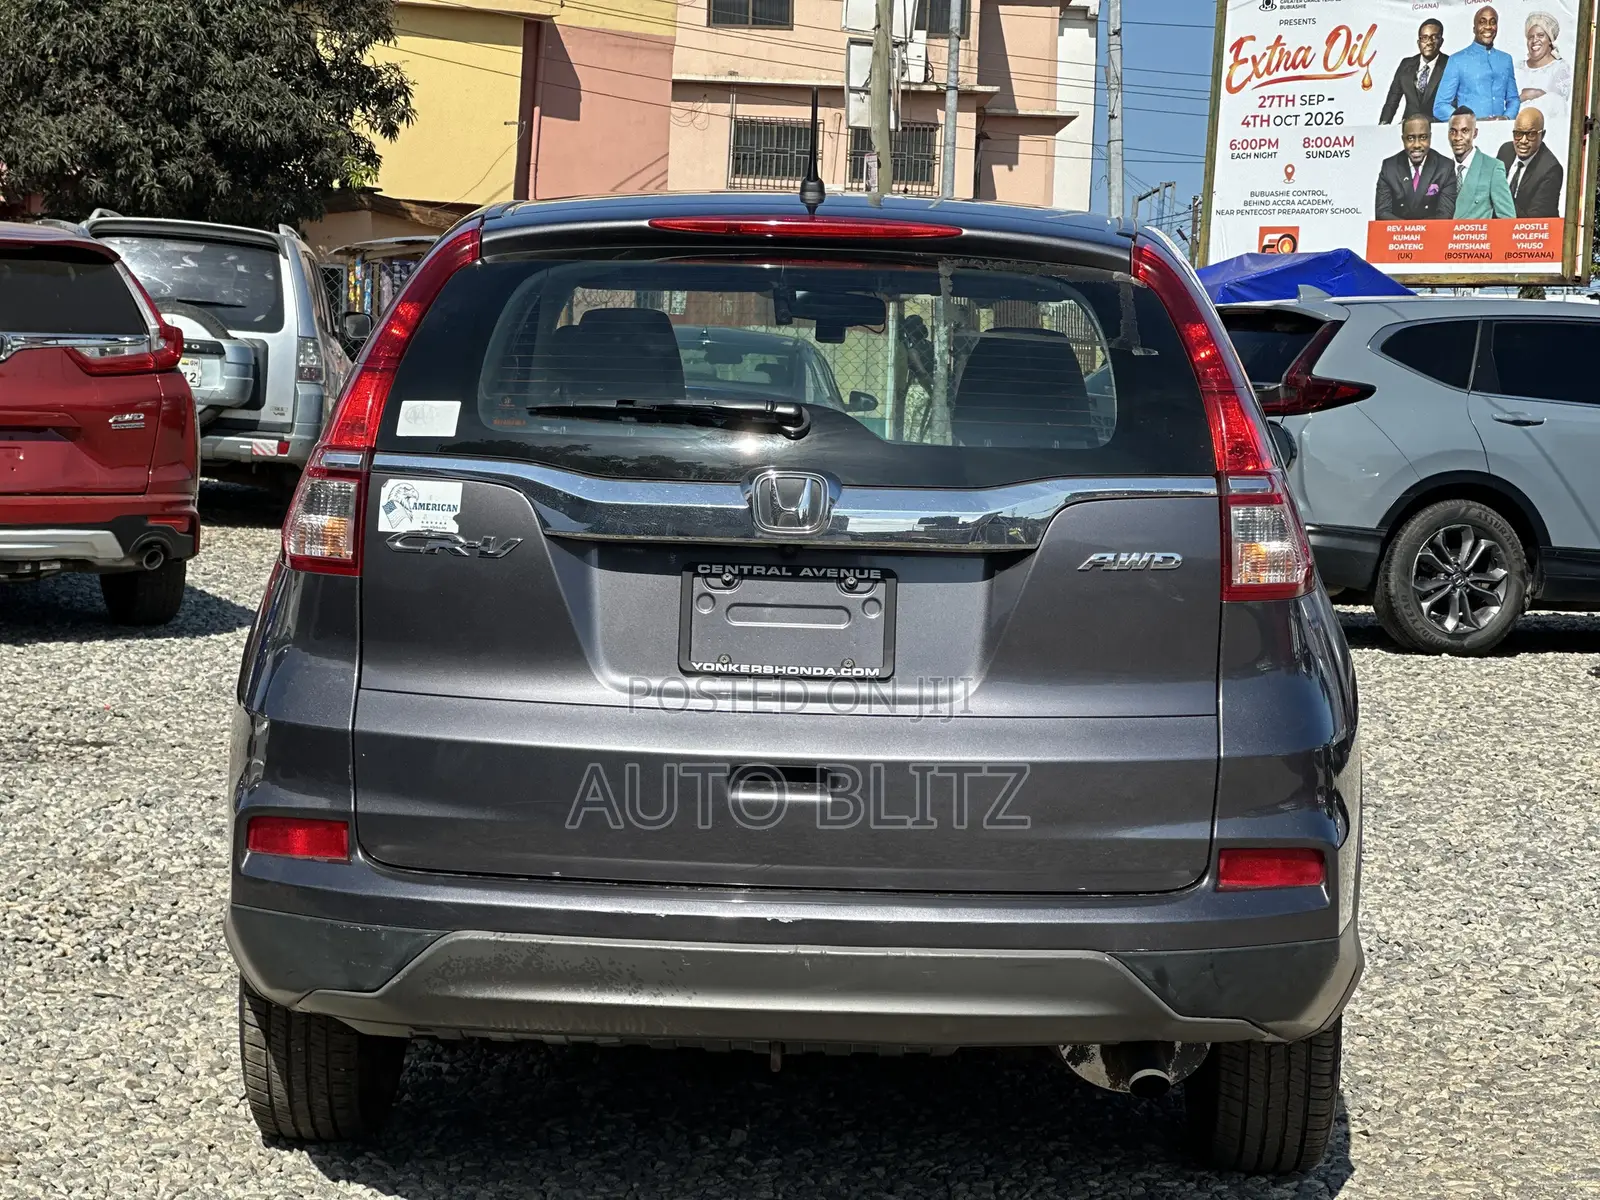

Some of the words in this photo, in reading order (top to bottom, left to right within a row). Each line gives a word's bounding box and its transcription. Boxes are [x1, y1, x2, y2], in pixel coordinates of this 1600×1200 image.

[1411, 3, 1440, 11] (GHANA)
[1279, 18, 1317, 26] PRESENTS
[1225, 34, 1316, 94] Extra
[1323, 23, 1378, 72] Oil
[1258, 94, 1296, 108] 27TH
[1240, 114, 1271, 128] 4TH
[1273, 114, 1300, 127] OCT
[1304, 111, 1344, 127] 2026
[1229, 138, 1279, 151] 6:00PM
[1302, 135, 1355, 149] 8:00AM
[1230, 152, 1252, 160] EACH
[1253, 151, 1278, 159] NIGHT
[1305, 149, 1350, 159] SUNDAYS
[1250, 190, 1290, 198] BUBUASHIE
[1292, 189, 1328, 197] CONTROL,
[1243, 199, 1271, 207] BEHIND
[1272, 199, 1296, 207] ACCRA
[1297, 198, 1334, 206] ACADEMY,
[1236, 208, 1276, 216] PENTECOST
[1277, 207, 1329, 215] PREPARATORY
[1404, 224, 1427, 232] MARK
[1513, 223, 1549, 231] APOSTLE
[1452, 233, 1488, 241] MOTHUSI
[1512, 232, 1550, 240] MOLEFHE
[1447, 242, 1491, 250] PHITSHANE
[1516, 242, 1544, 250] YHUSO
[1397, 252, 1413, 261] (UK)
[1444, 251, 1493, 261] (BOSTWANA)
[1504, 250, 1555, 260] (BOSTWANA)
[412, 502, 459, 512] AMERICAN
[386, 530, 524, 559] CR-V
[1077, 552, 1183, 571] AWD
[697, 564, 793, 576] CENTRAL
[799, 567, 882, 579] AVENUE
[691, 661, 880, 677] YONKERSHONDA.COM
